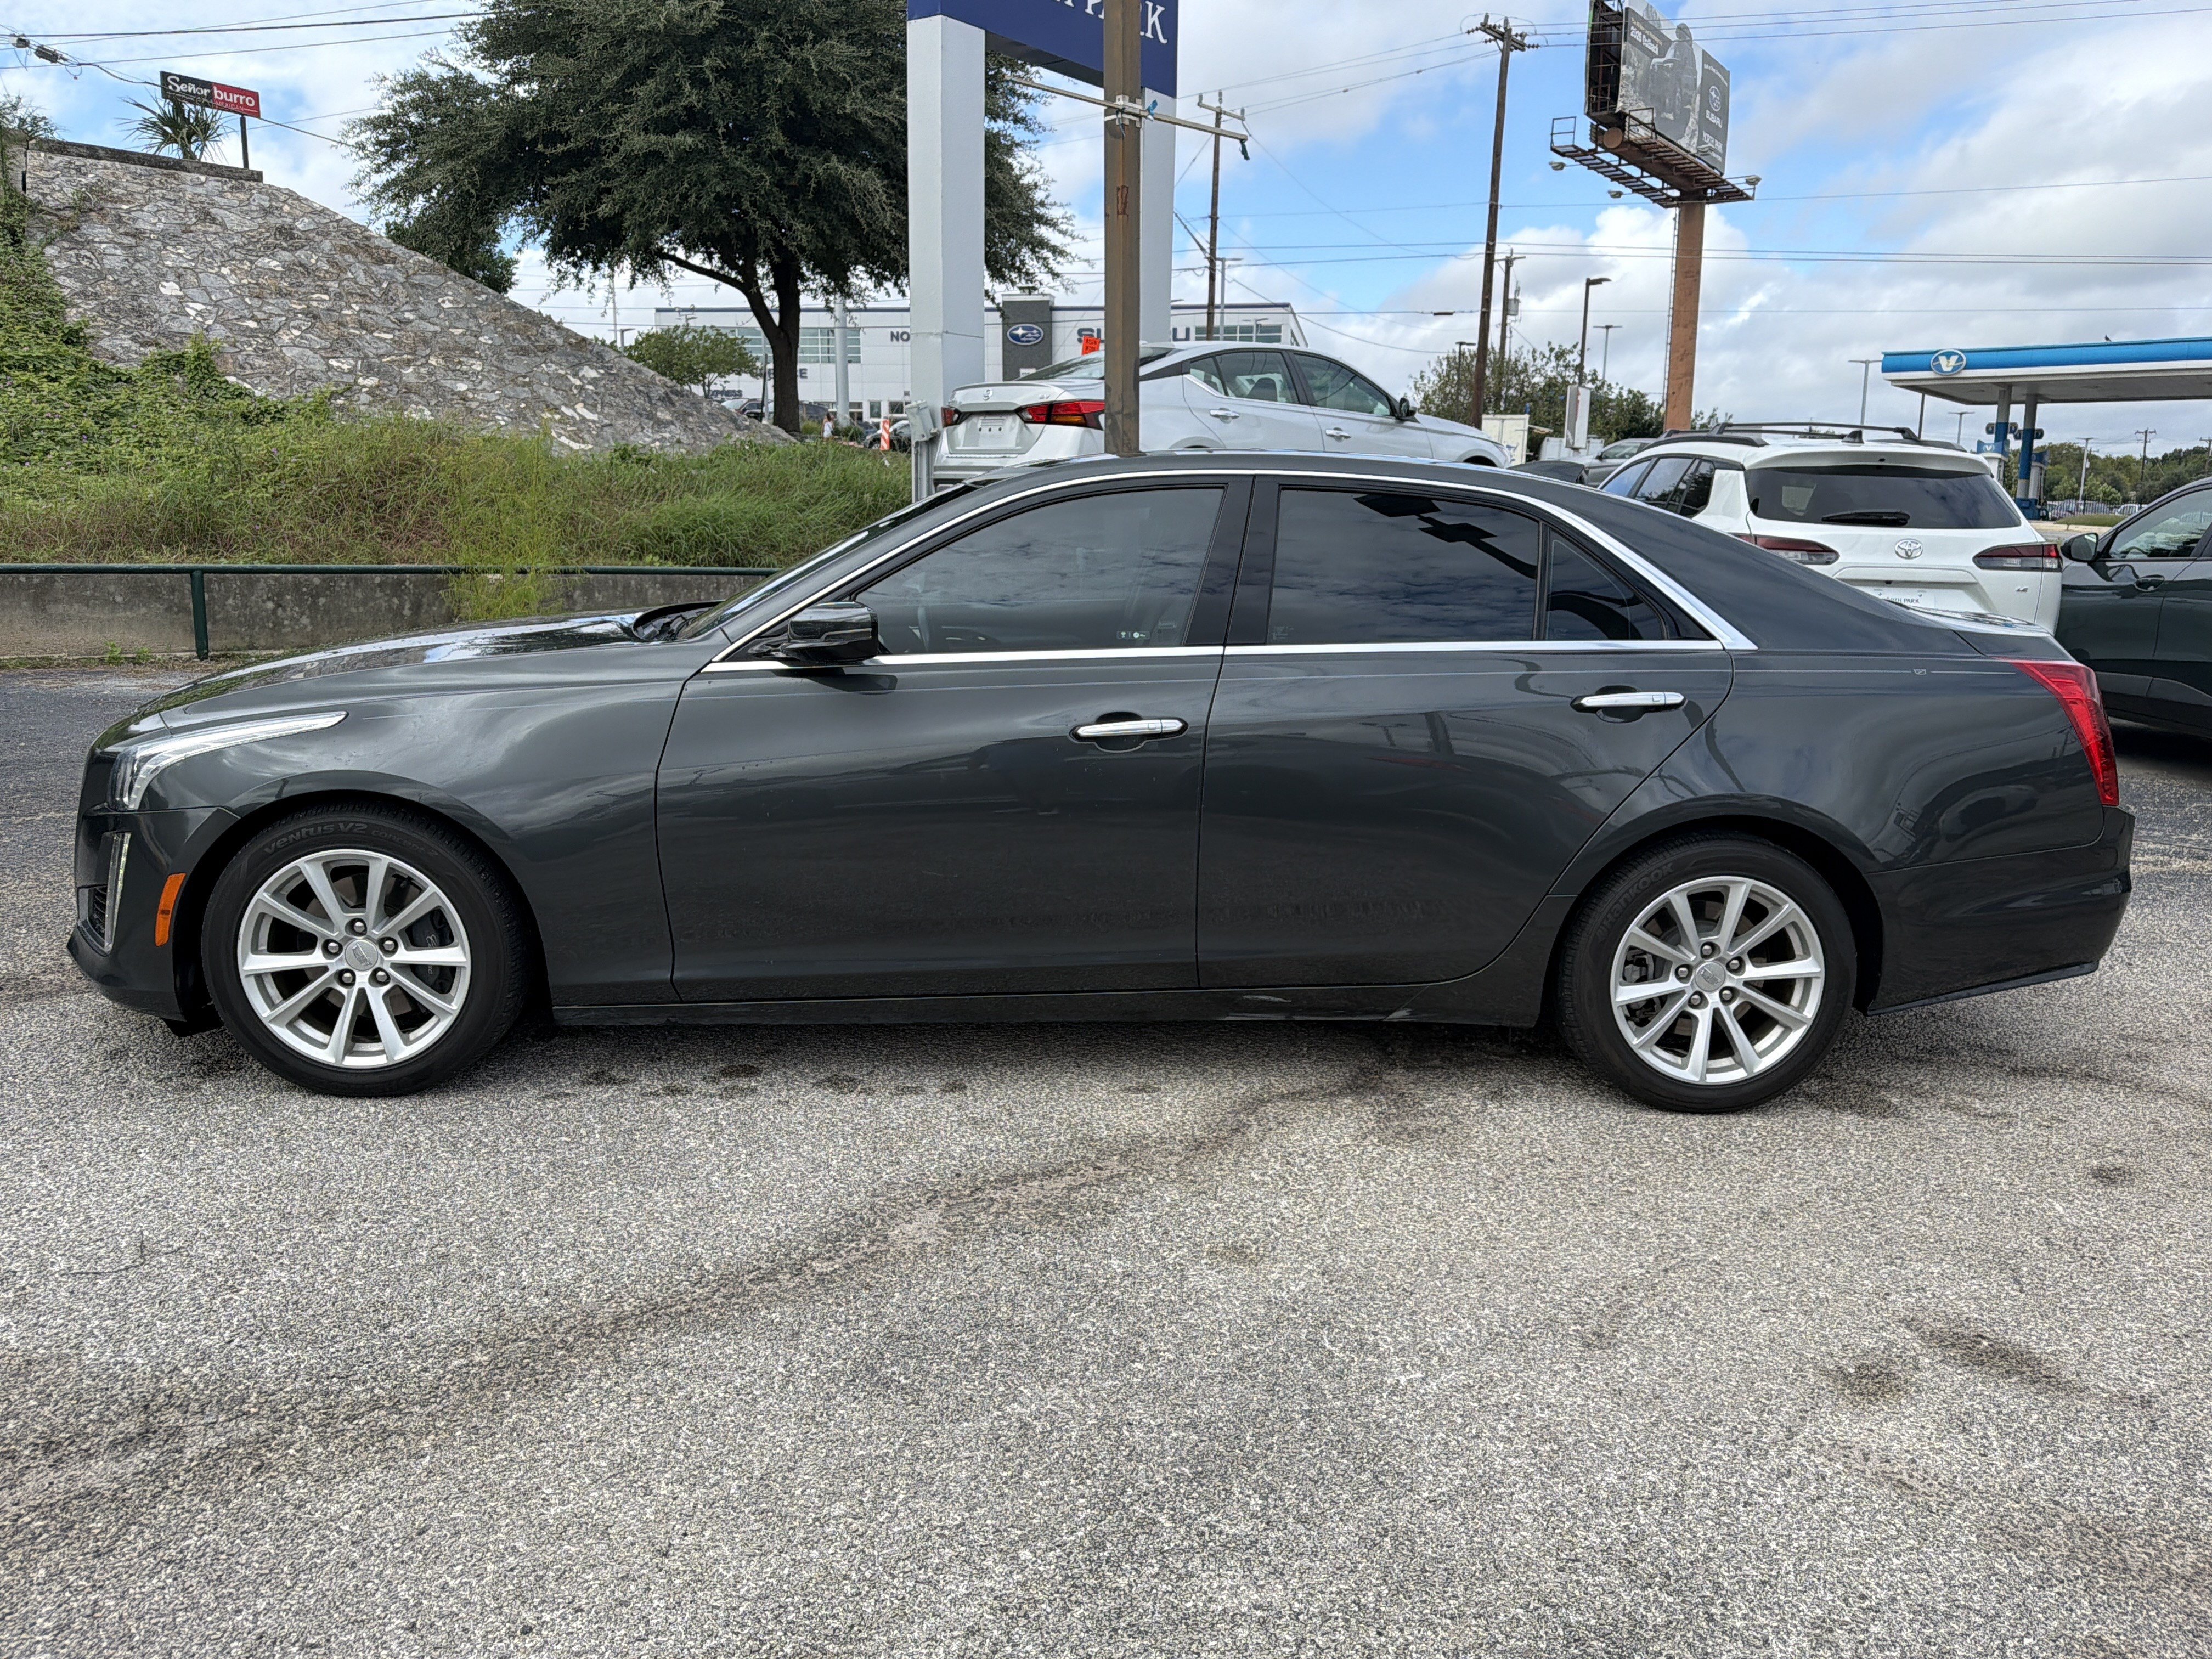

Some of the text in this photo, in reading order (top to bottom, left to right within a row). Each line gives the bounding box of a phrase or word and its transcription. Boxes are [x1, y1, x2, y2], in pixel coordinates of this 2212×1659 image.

[167, 75, 255, 106] Señor burro
[338, 822, 368, 834] V2
